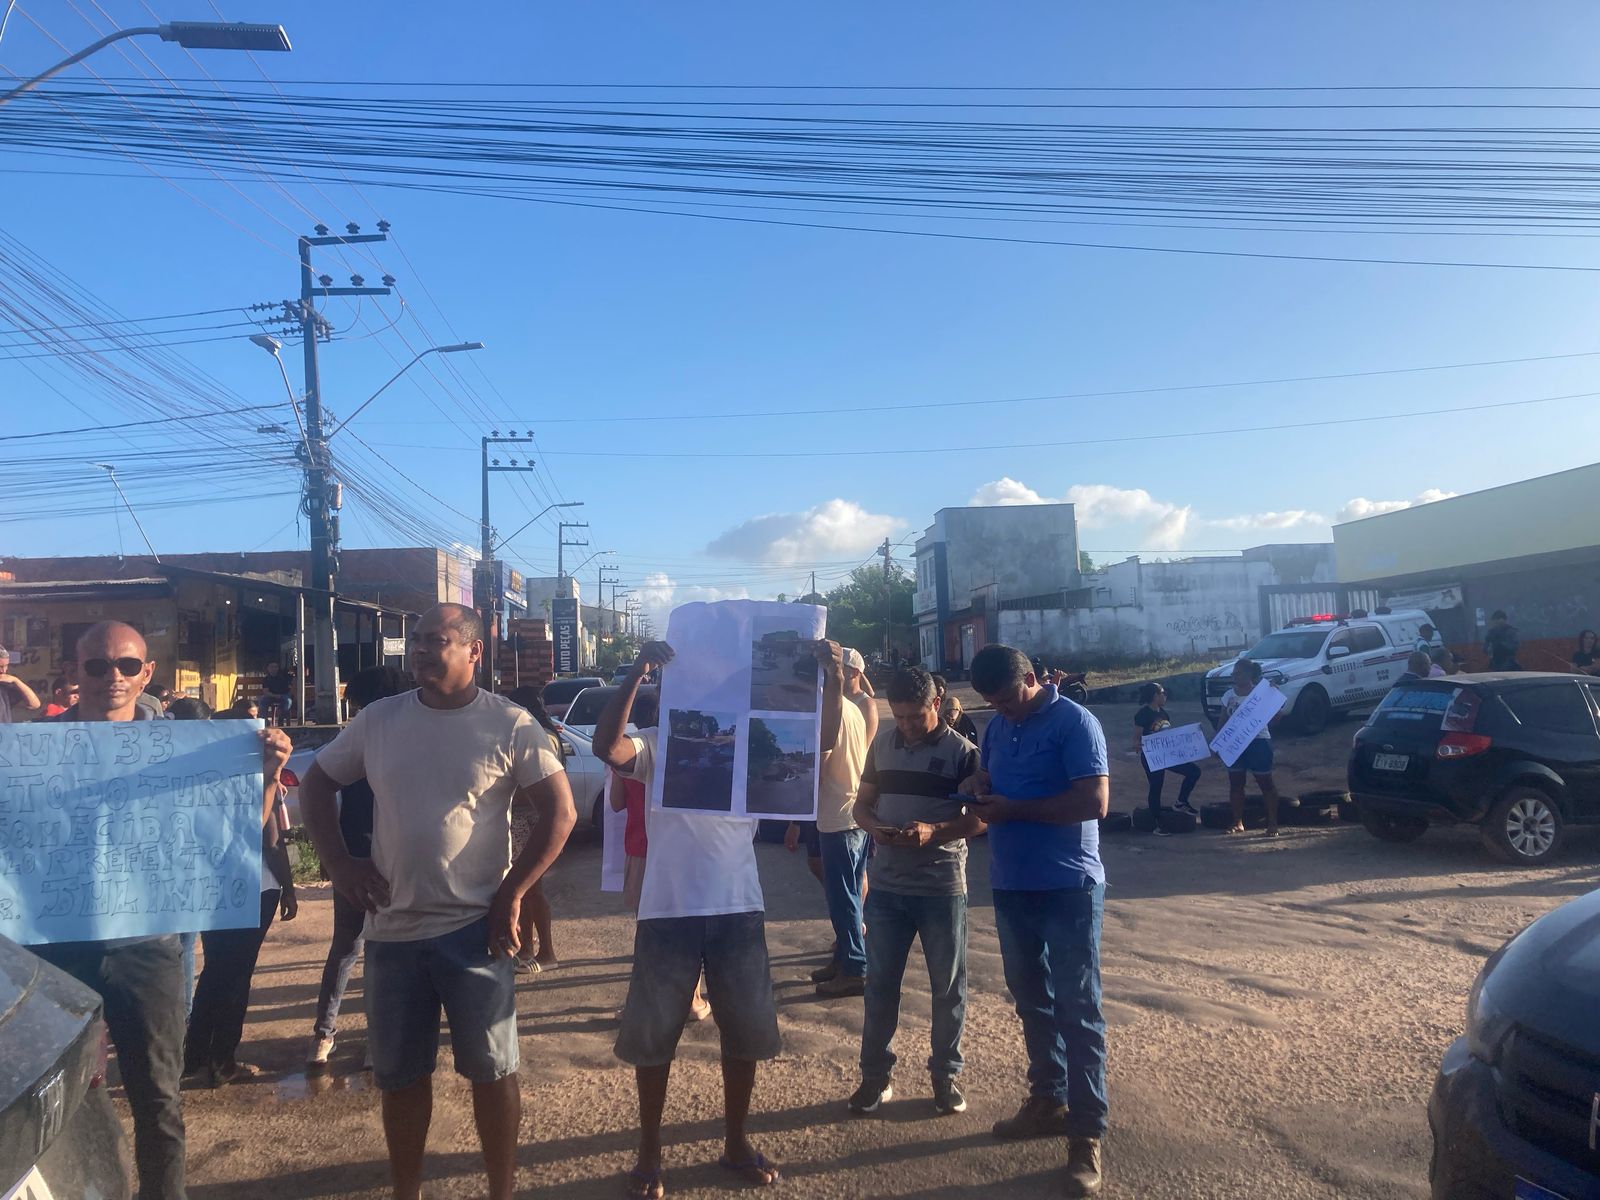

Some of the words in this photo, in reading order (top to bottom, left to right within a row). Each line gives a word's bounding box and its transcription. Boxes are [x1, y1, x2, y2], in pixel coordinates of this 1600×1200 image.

[560, 625, 573, 650] PEÇAS
[560, 651, 571, 671] AUTO
[113, 726, 174, 764] 33
[74, 776, 130, 811] DO
[137, 770, 257, 810] TURU
[46, 844, 225, 876] PREFEITO
[36, 873, 248, 920] JULINHO
